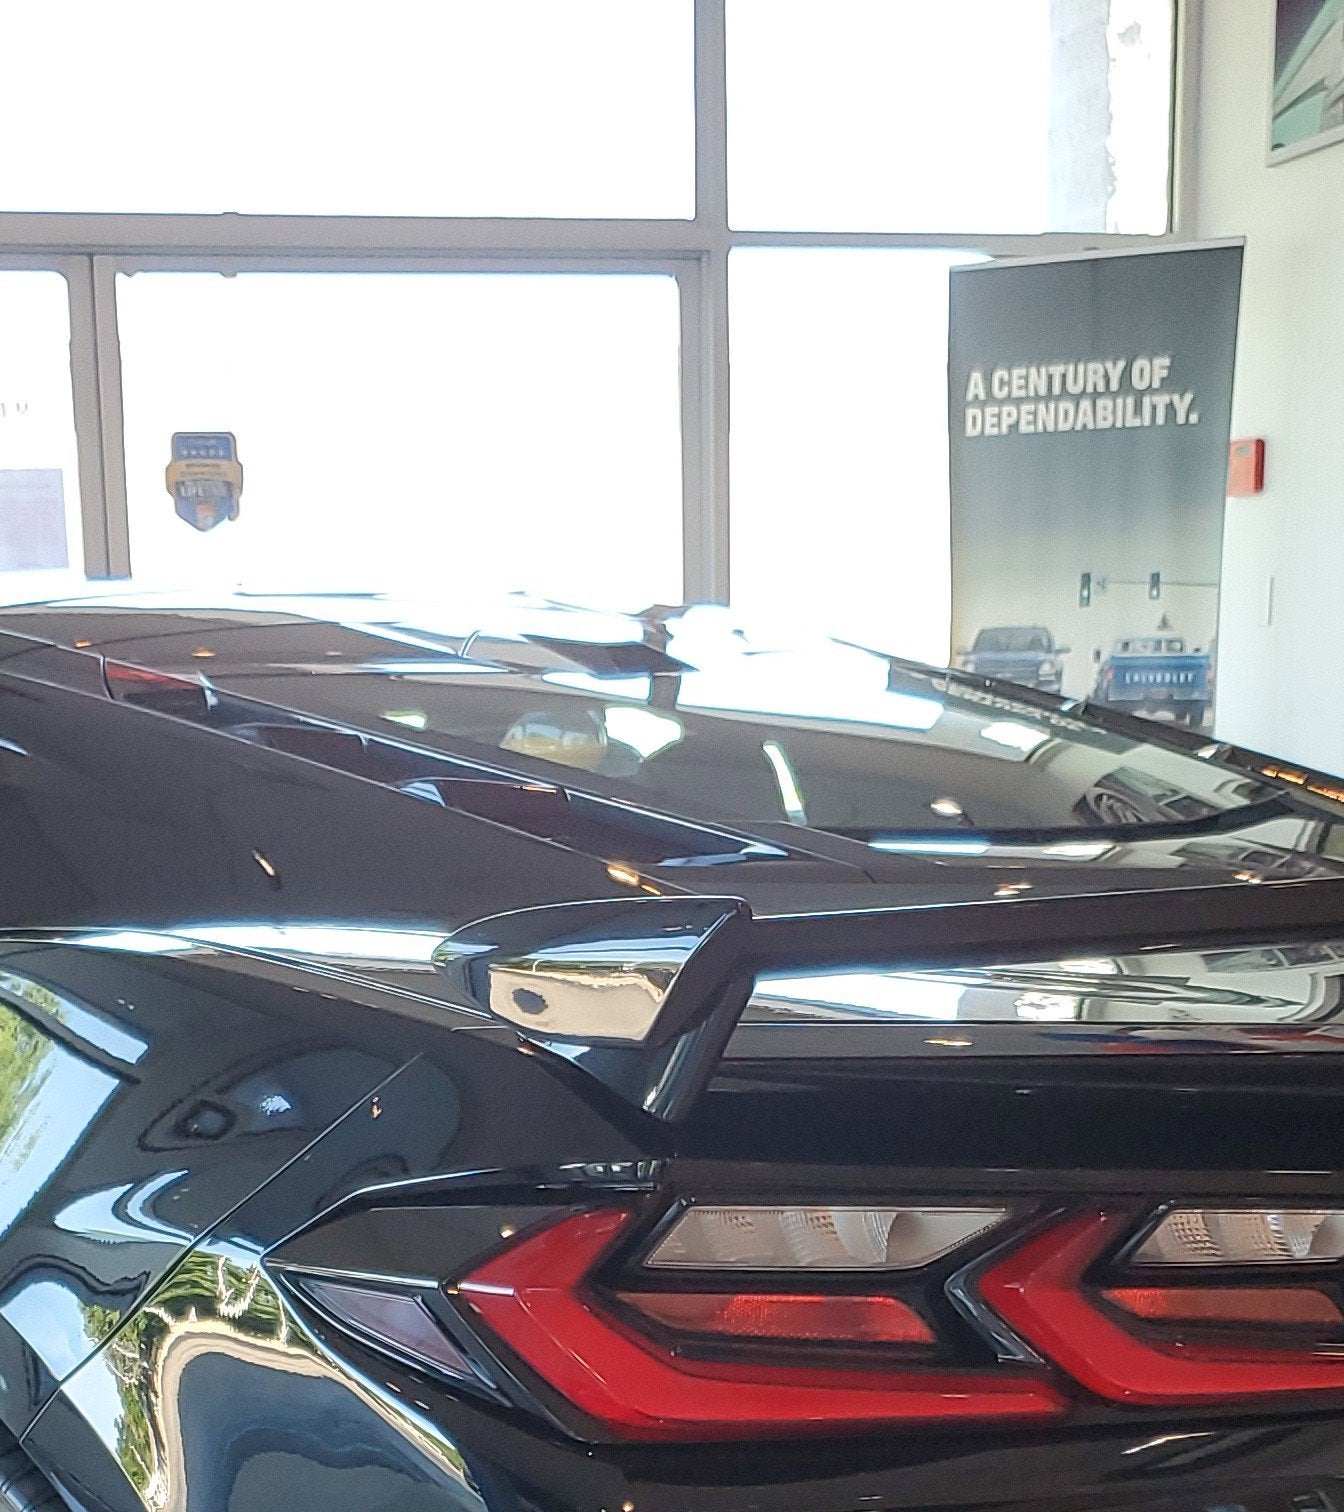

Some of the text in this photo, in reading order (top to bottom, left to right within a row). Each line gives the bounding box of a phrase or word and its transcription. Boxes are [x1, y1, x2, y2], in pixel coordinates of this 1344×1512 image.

[966, 356, 1170, 400] A CENTURY OF
[965, 391, 1198, 436] DEPENDABILITY.
